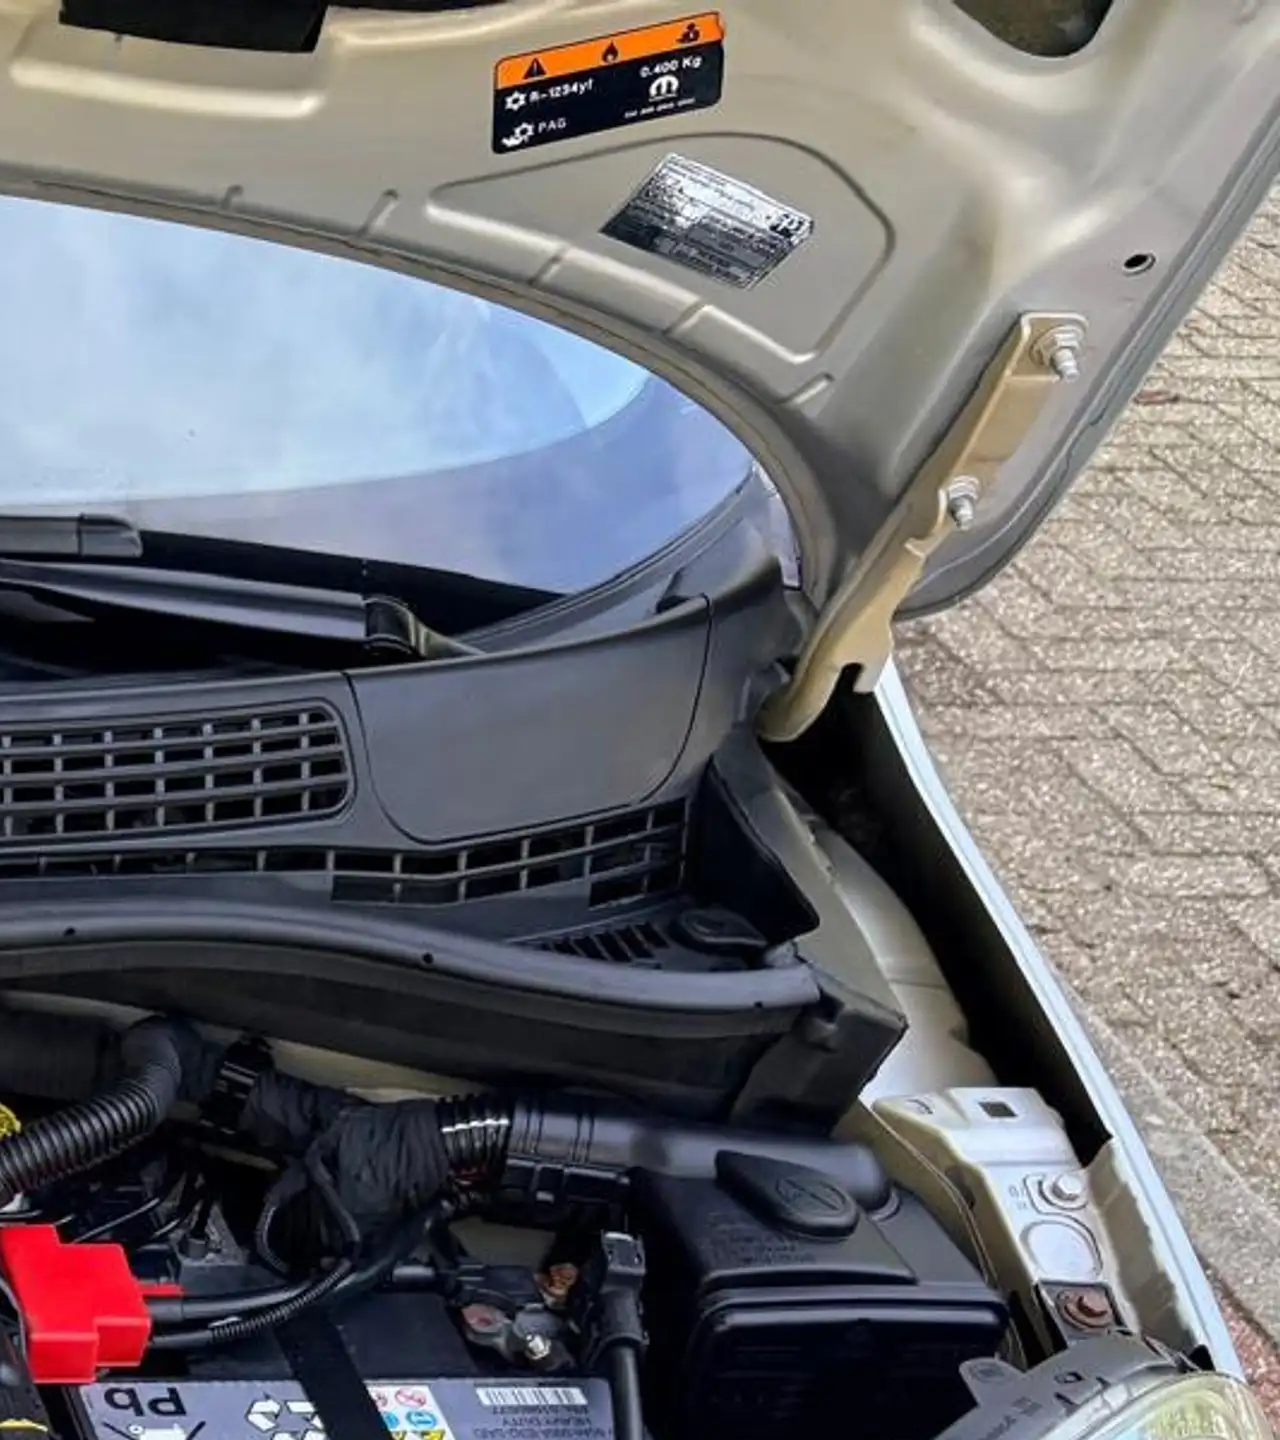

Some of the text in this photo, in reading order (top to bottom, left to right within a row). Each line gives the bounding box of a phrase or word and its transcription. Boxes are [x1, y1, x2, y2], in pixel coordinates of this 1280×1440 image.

[640, 54, 703, 78] 0.400 Kg
[538, 116, 568, 134] PAG
[104, 1386, 188, 1417] Pb
